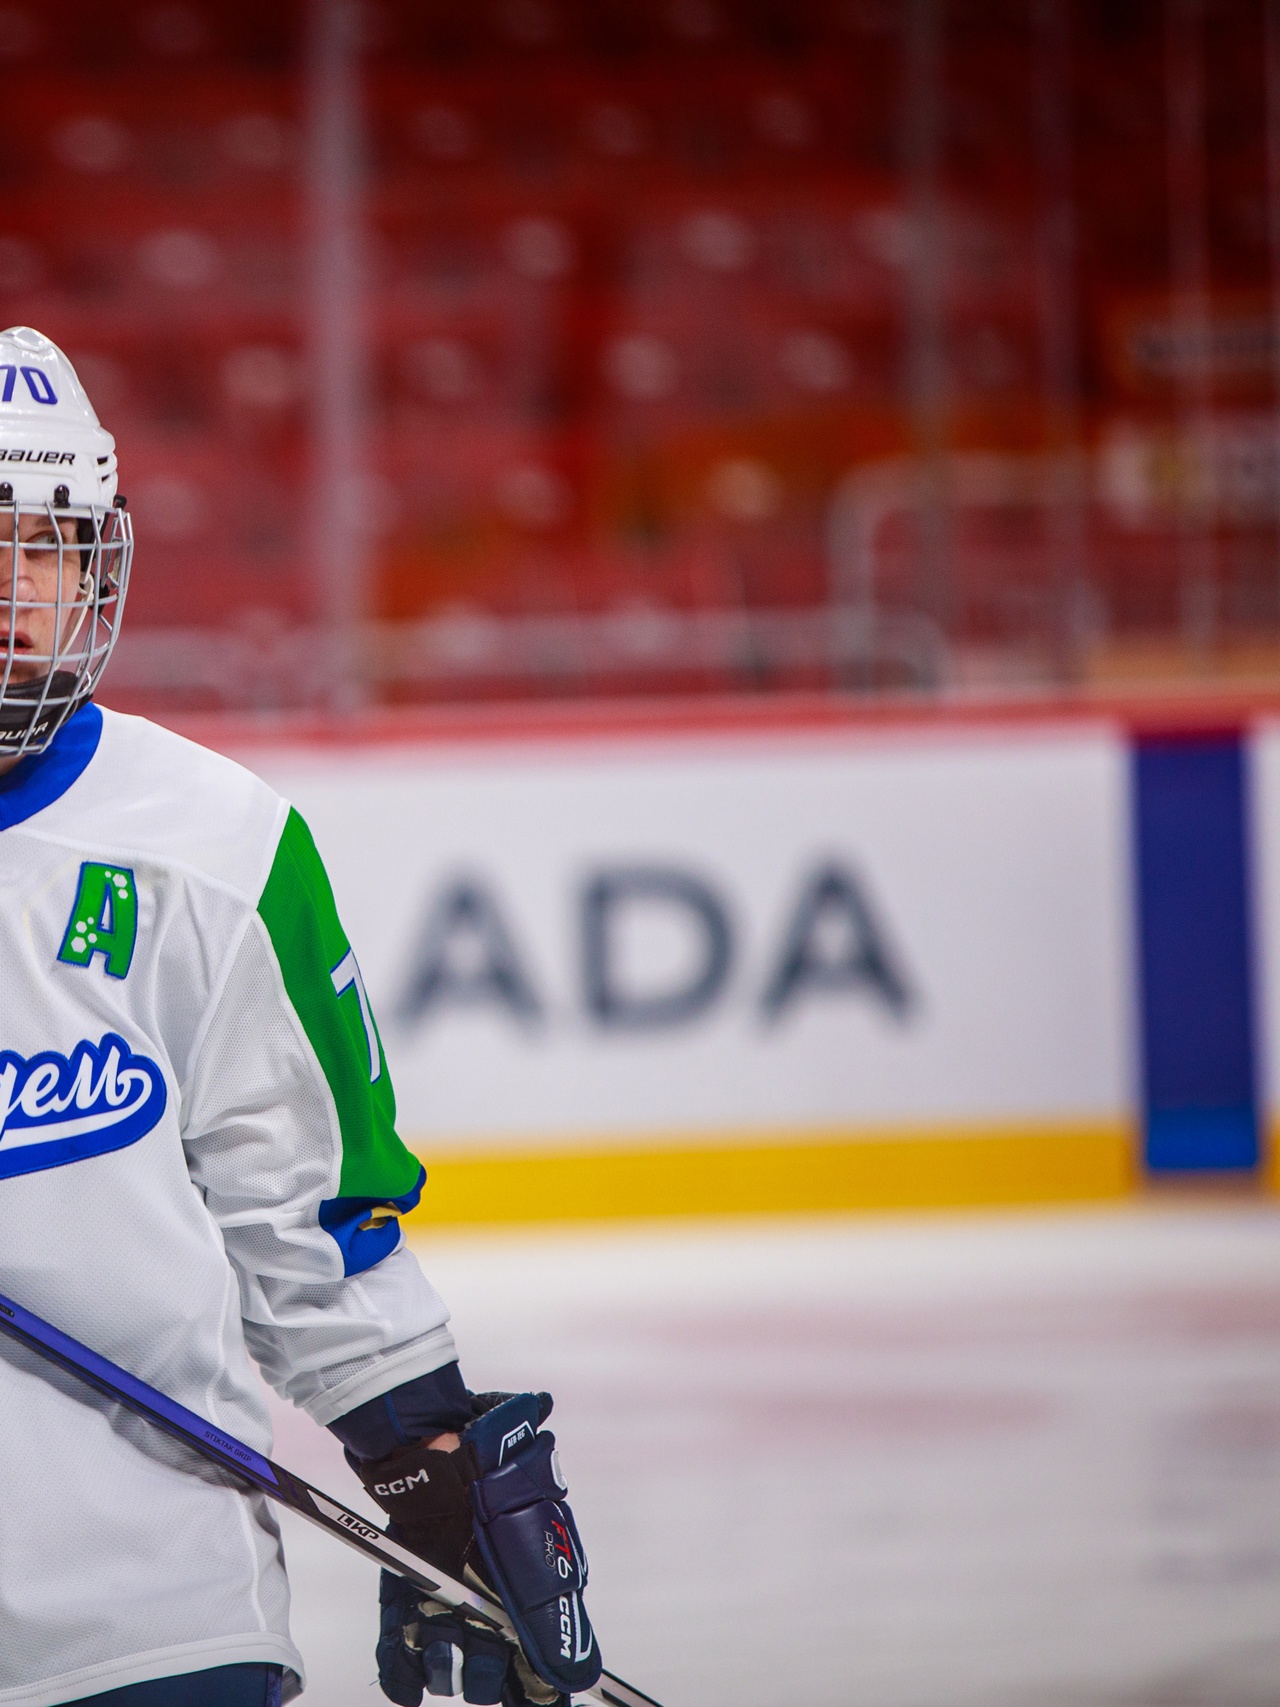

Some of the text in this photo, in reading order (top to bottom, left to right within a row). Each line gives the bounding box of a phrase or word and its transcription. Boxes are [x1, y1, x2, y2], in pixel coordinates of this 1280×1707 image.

[205, 1431, 252, 1462] STIKTAK GRIP
[374, 1468, 430, 1497] CCM
[544, 1530, 556, 1569] PRO
[559, 1595, 572, 1660] CCM
